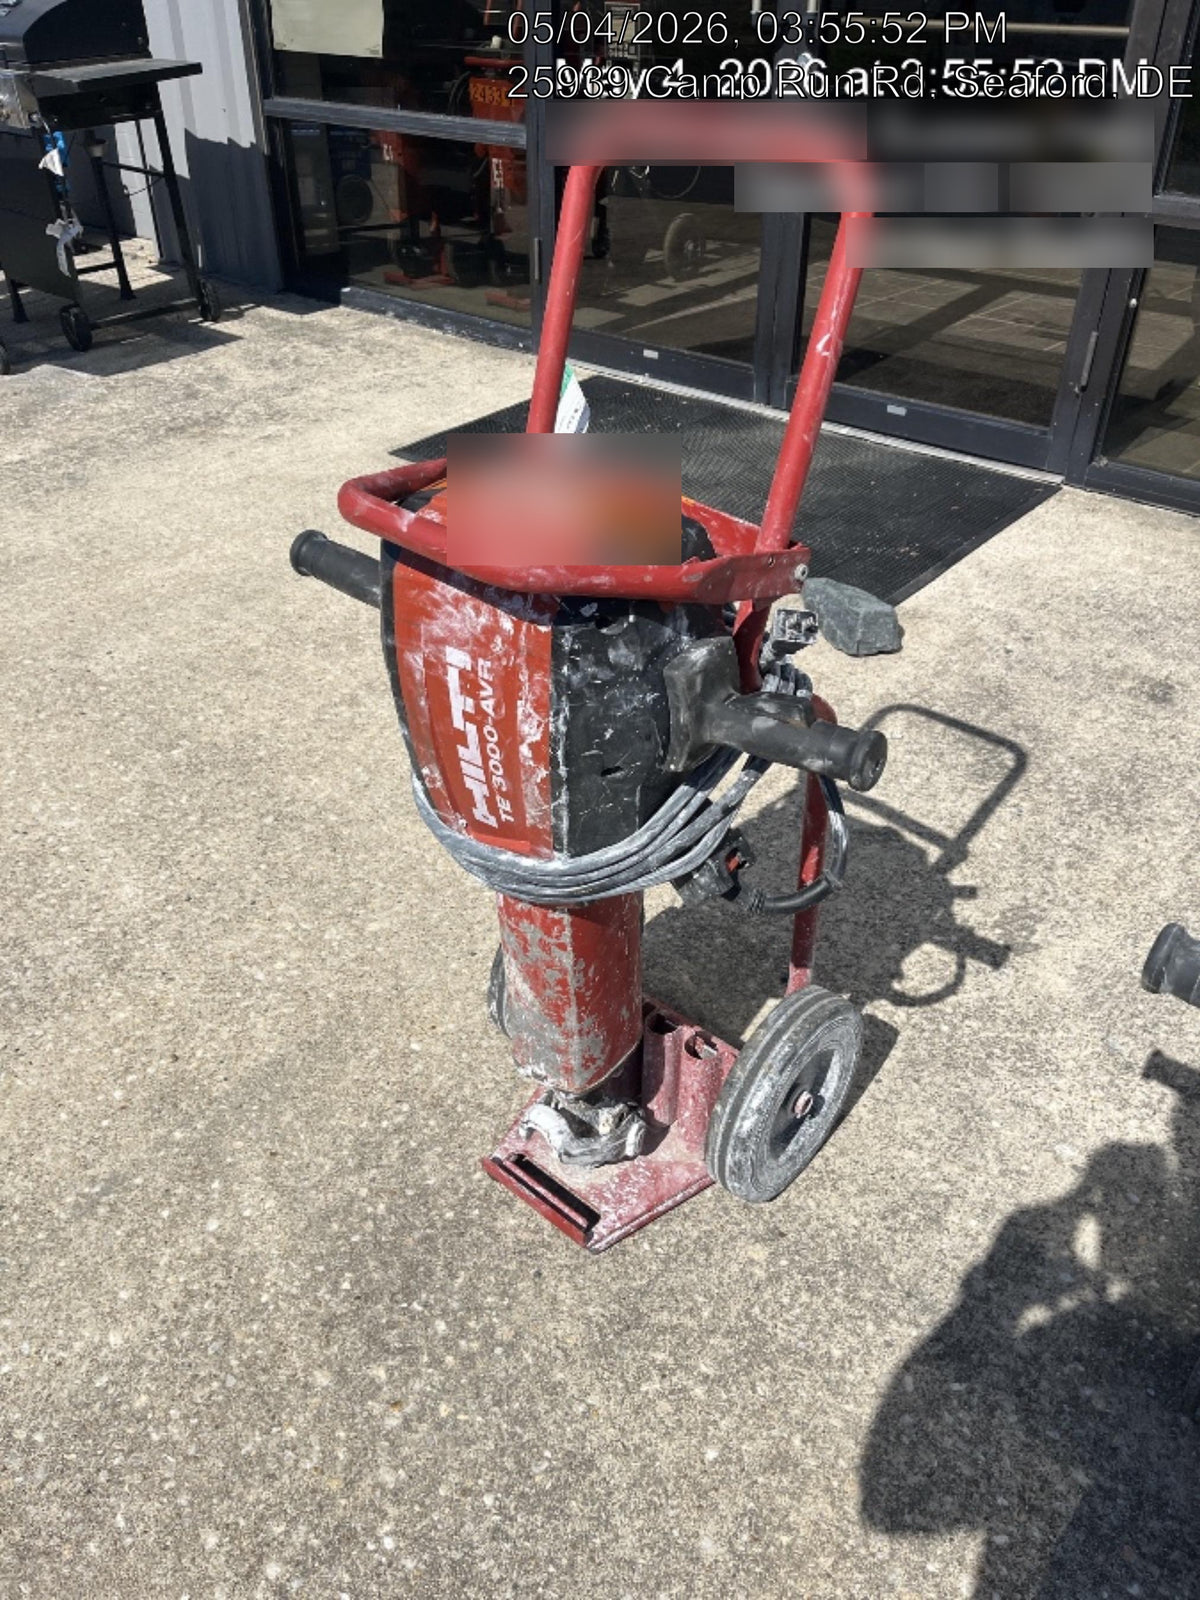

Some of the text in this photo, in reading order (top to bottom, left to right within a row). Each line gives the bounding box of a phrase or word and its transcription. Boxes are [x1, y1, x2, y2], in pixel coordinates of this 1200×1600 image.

[445, 646, 498, 828] HILTI
[477, 657, 514, 822] TE 3000-AVR
